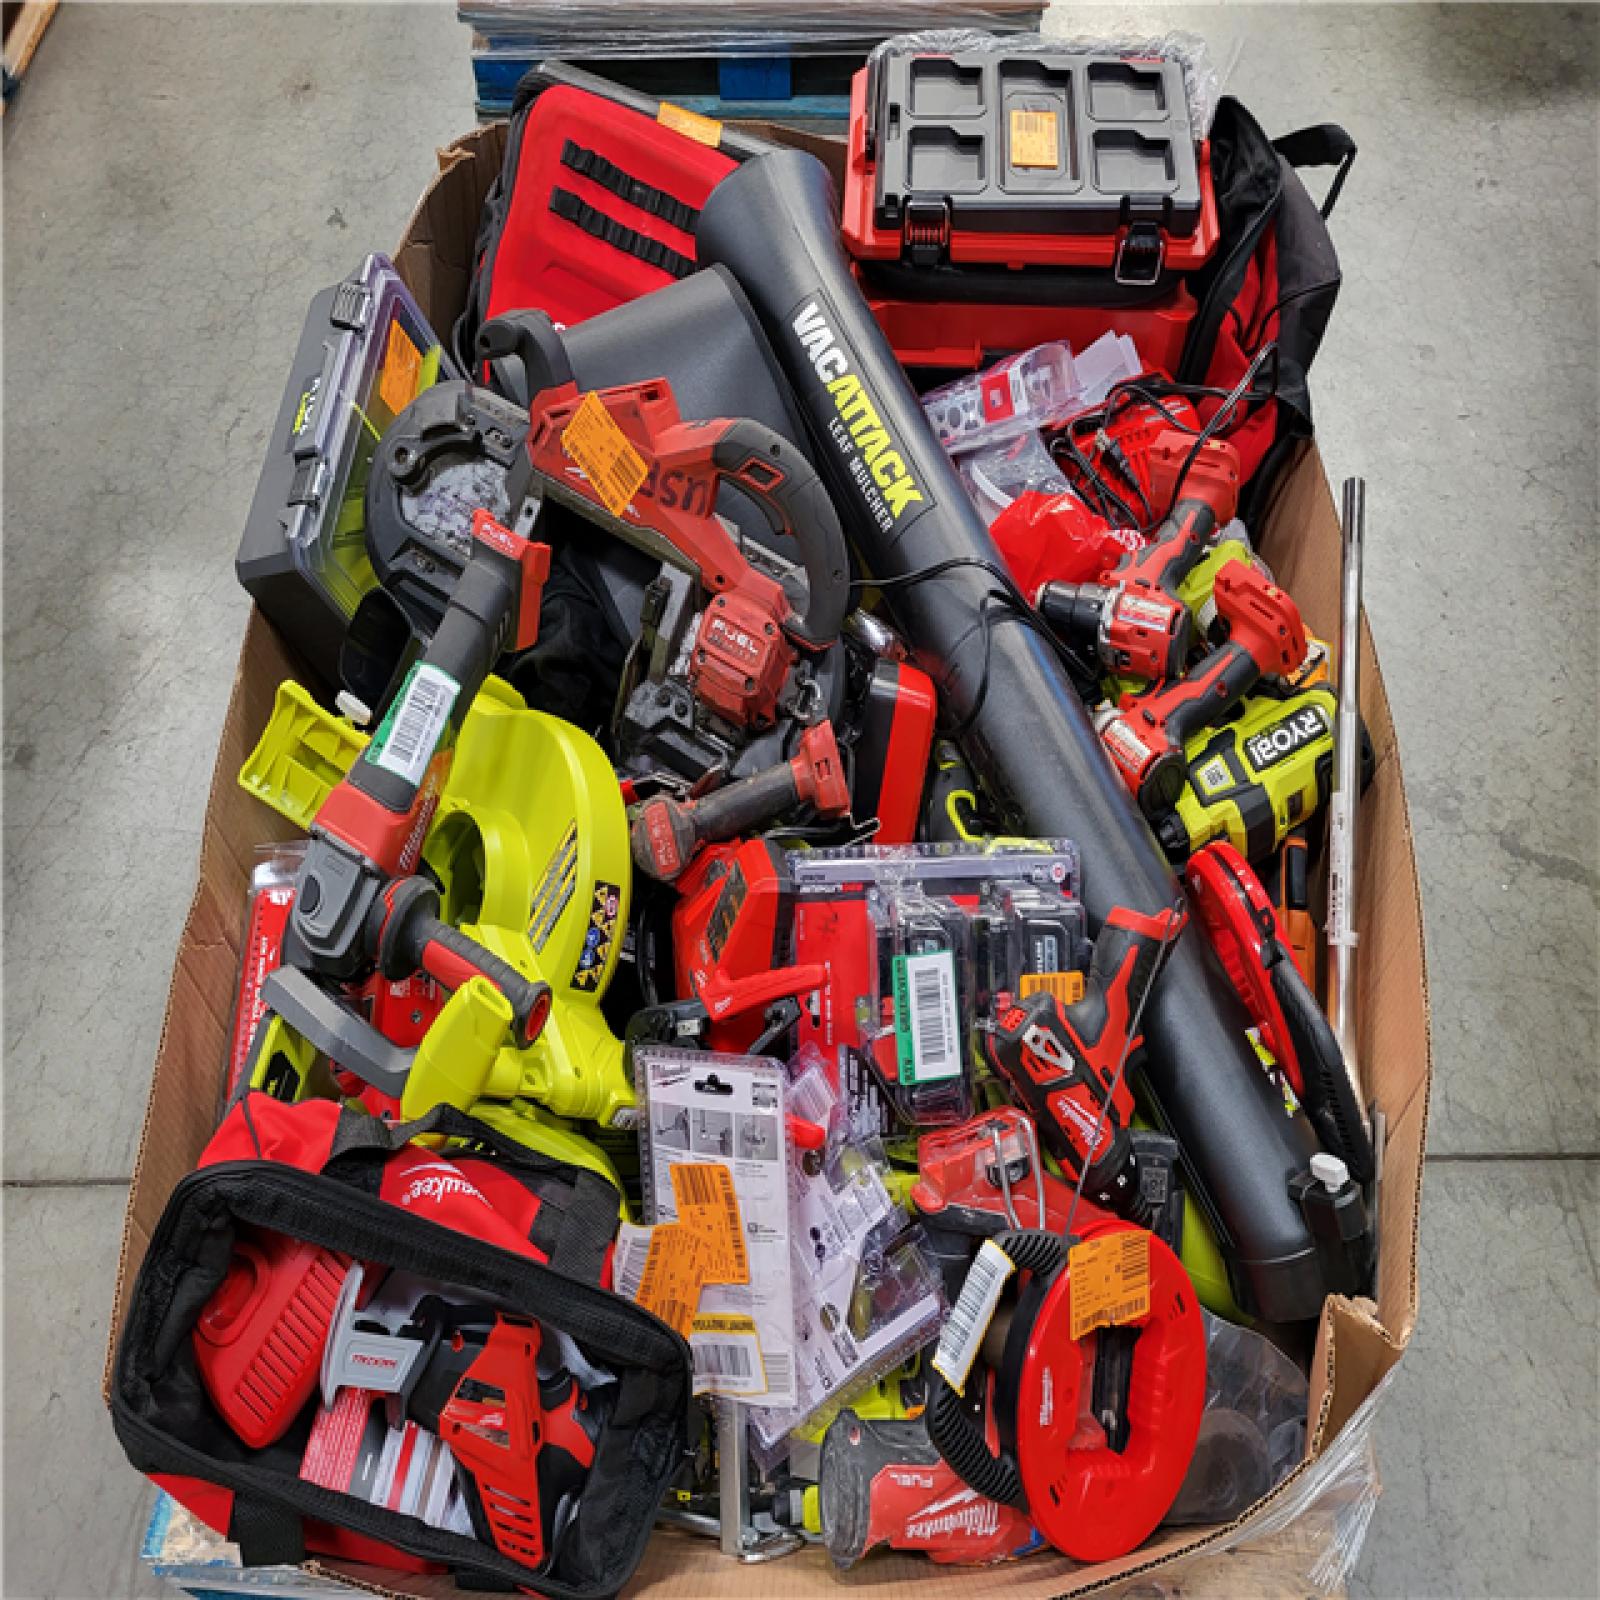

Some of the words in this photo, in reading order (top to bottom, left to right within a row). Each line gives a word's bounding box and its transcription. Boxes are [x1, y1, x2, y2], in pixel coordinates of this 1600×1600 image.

[828, 416, 854, 454] LEAF
[850, 456, 893, 534] MULCHER
[711, 618, 759, 656] FUEL
[1249, 710, 1323, 766] RYOBI
[889, 1473, 934, 1488] FUEL
[906, 1501, 1001, 1539] Milwaukee
